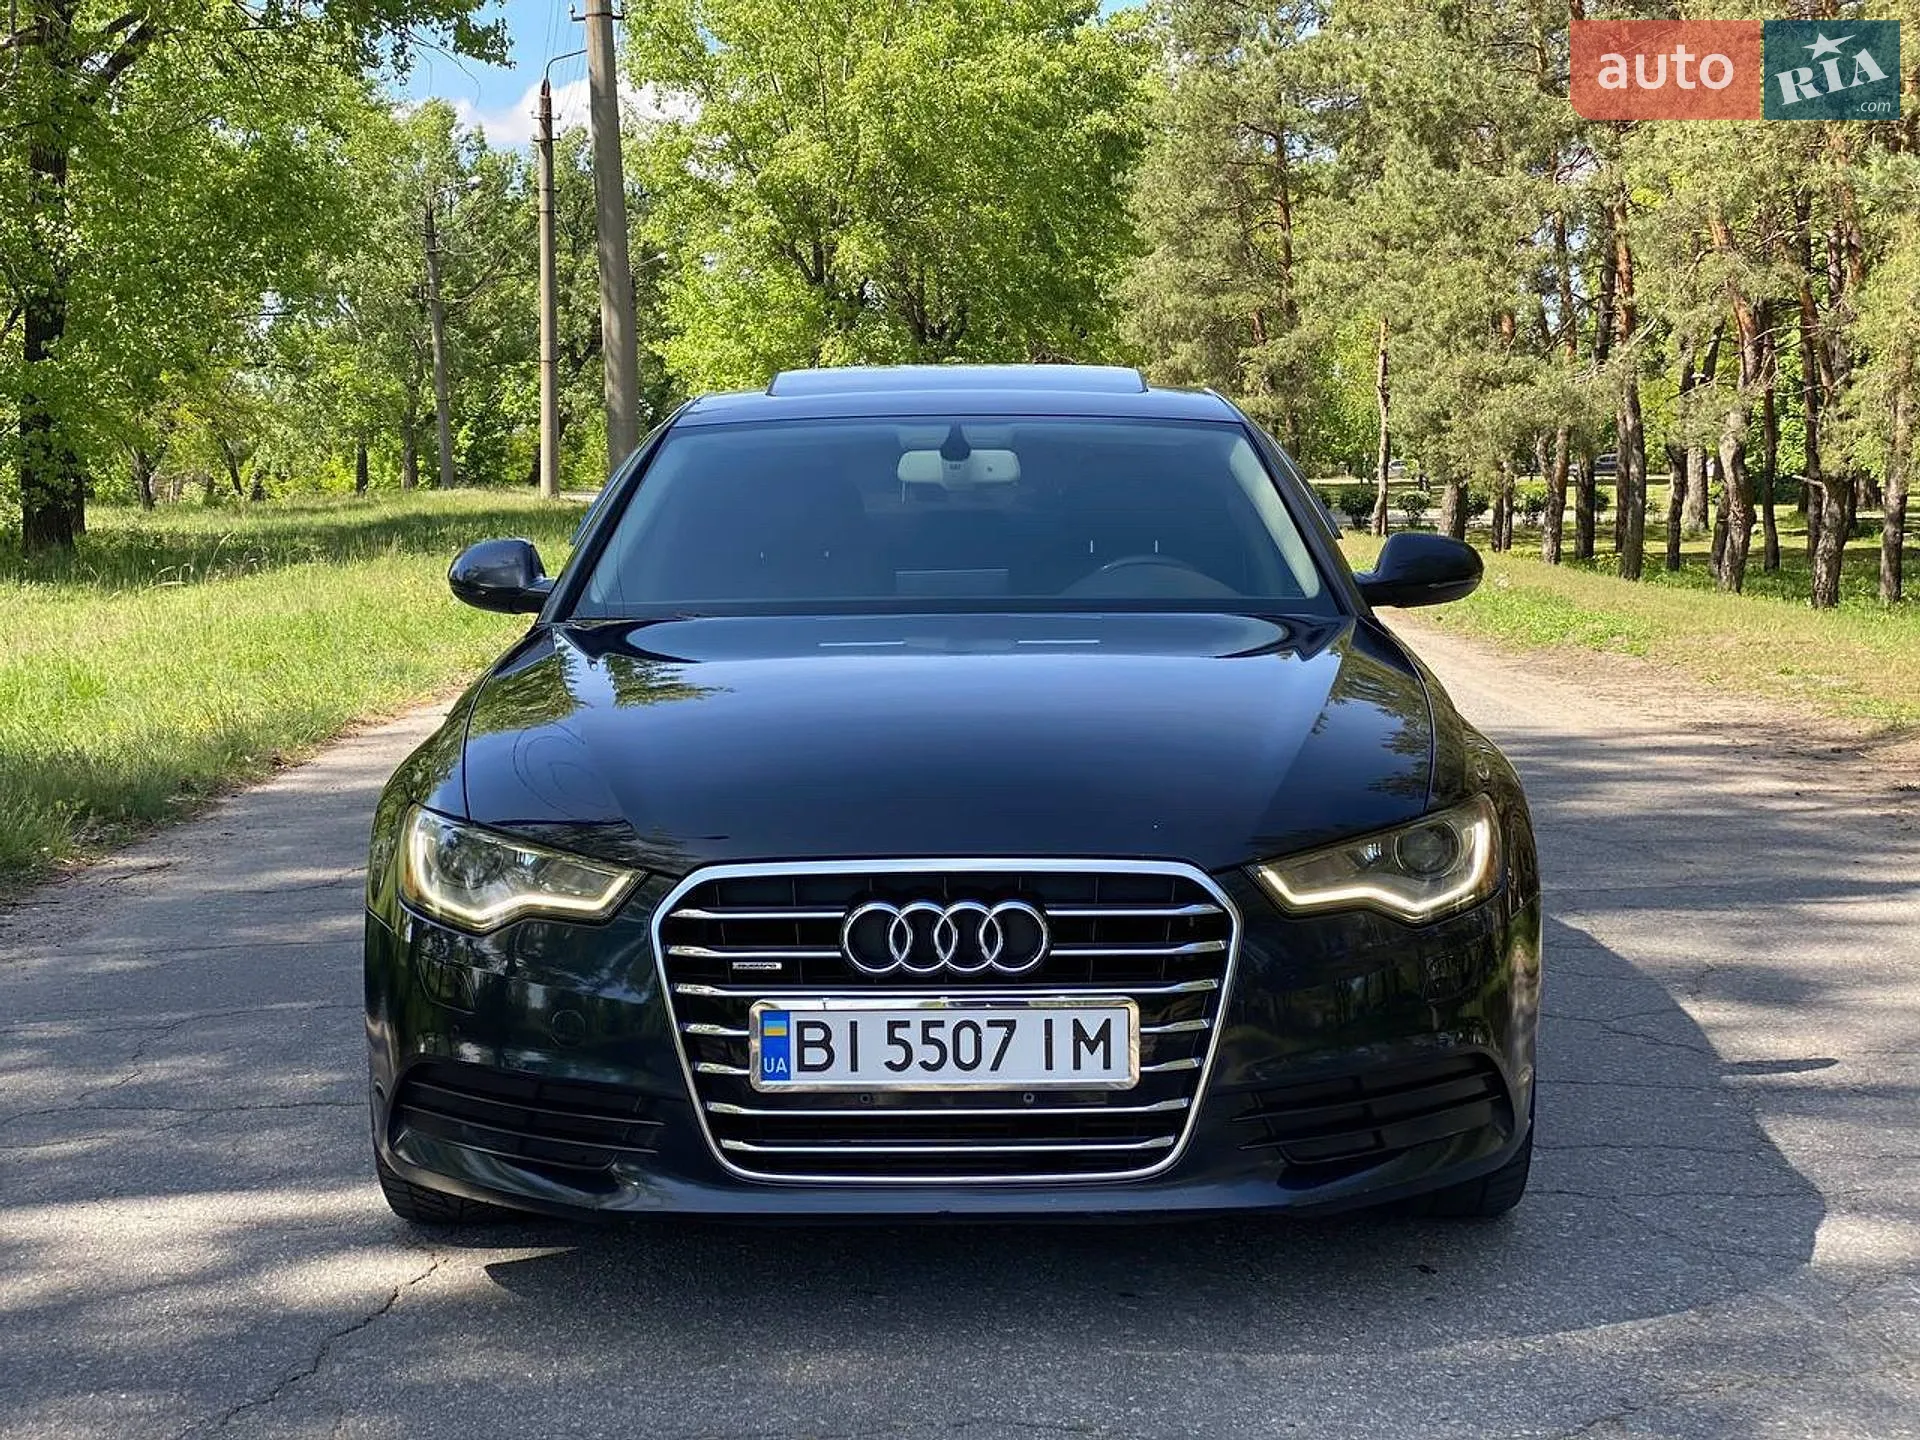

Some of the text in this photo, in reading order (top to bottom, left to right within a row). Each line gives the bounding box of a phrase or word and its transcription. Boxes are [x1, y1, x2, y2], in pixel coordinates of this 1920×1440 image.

[796, 1018, 1112, 1073] BI 5507 IM
[763, 1057, 788, 1074] UA
